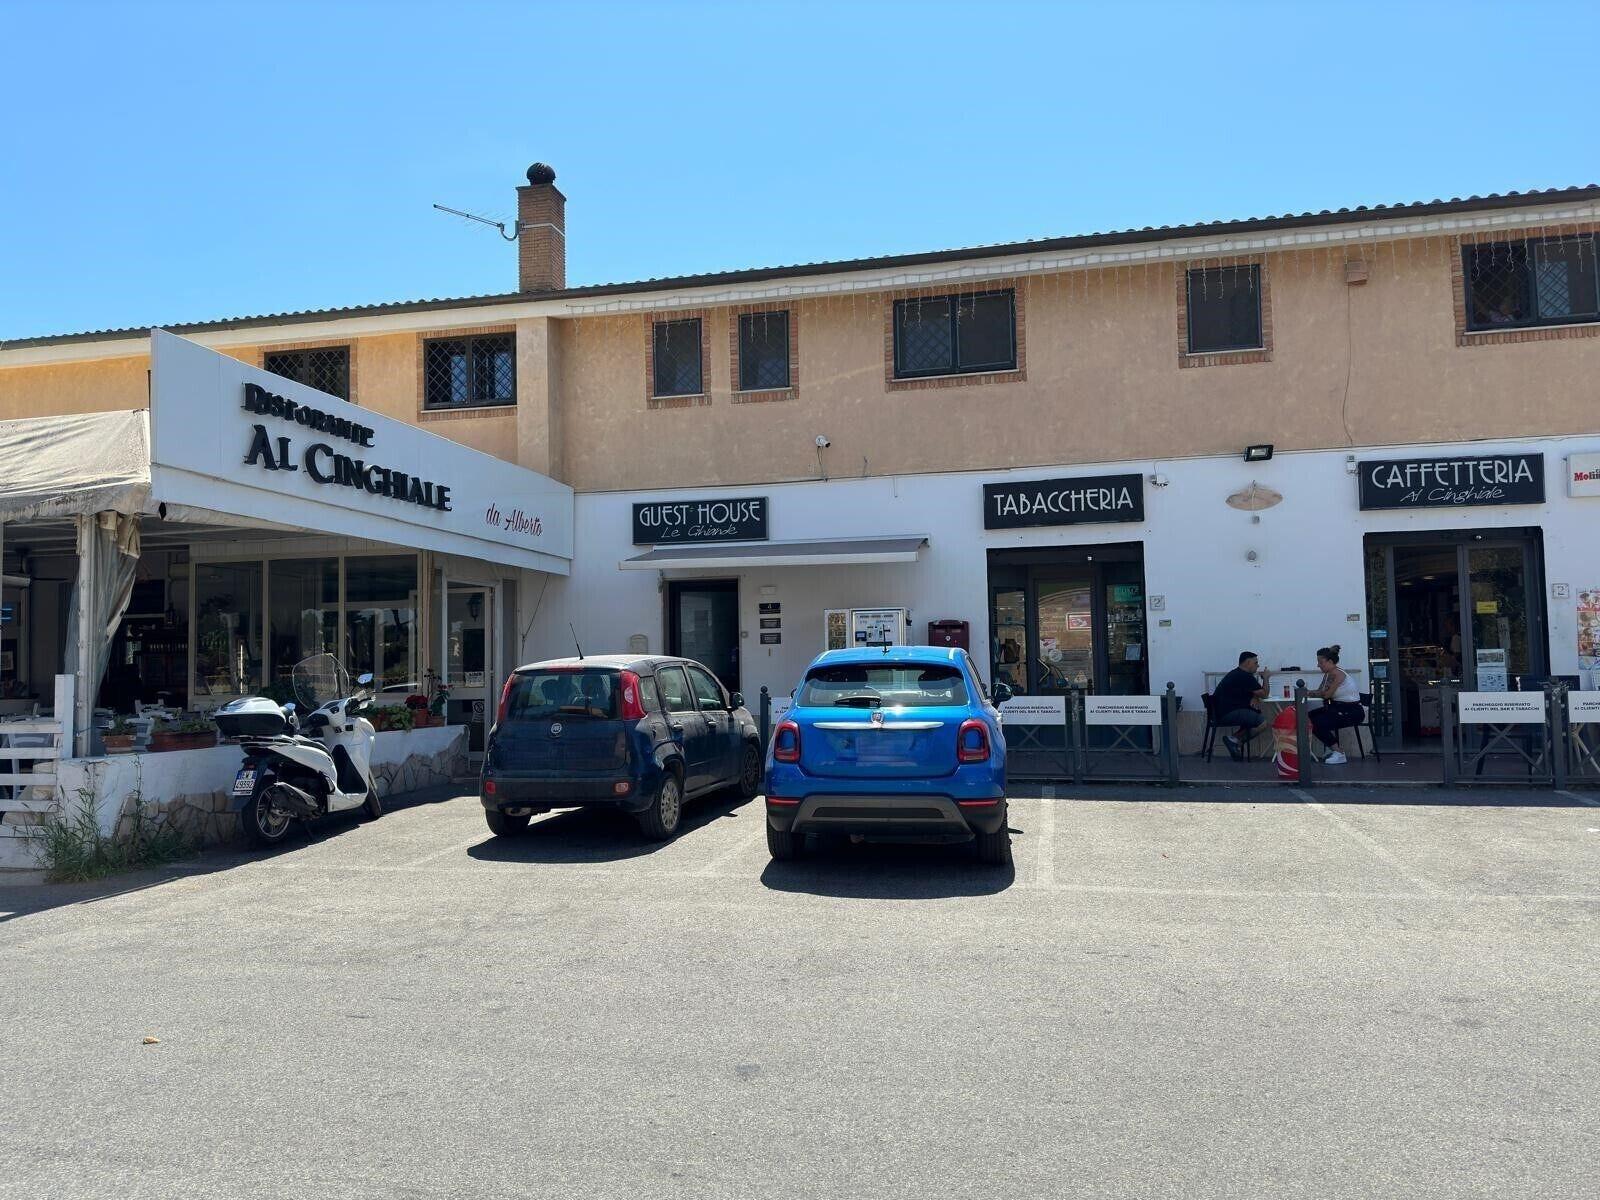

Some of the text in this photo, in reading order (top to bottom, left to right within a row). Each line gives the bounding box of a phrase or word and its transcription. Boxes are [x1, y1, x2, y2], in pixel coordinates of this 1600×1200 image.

[303, 443, 453, 512] CINGHIALE
[1371, 459, 1534, 489] CAFFETTERIA
[993, 487, 1134, 516] TABACCHERIA
[1400, 486, 1506, 504] Al Cinghiale
[485, 502, 543, 537] da Alberto
[639, 501, 761, 527] GUEST HOUSE
[661, 523, 738, 539] Le Ghiande
